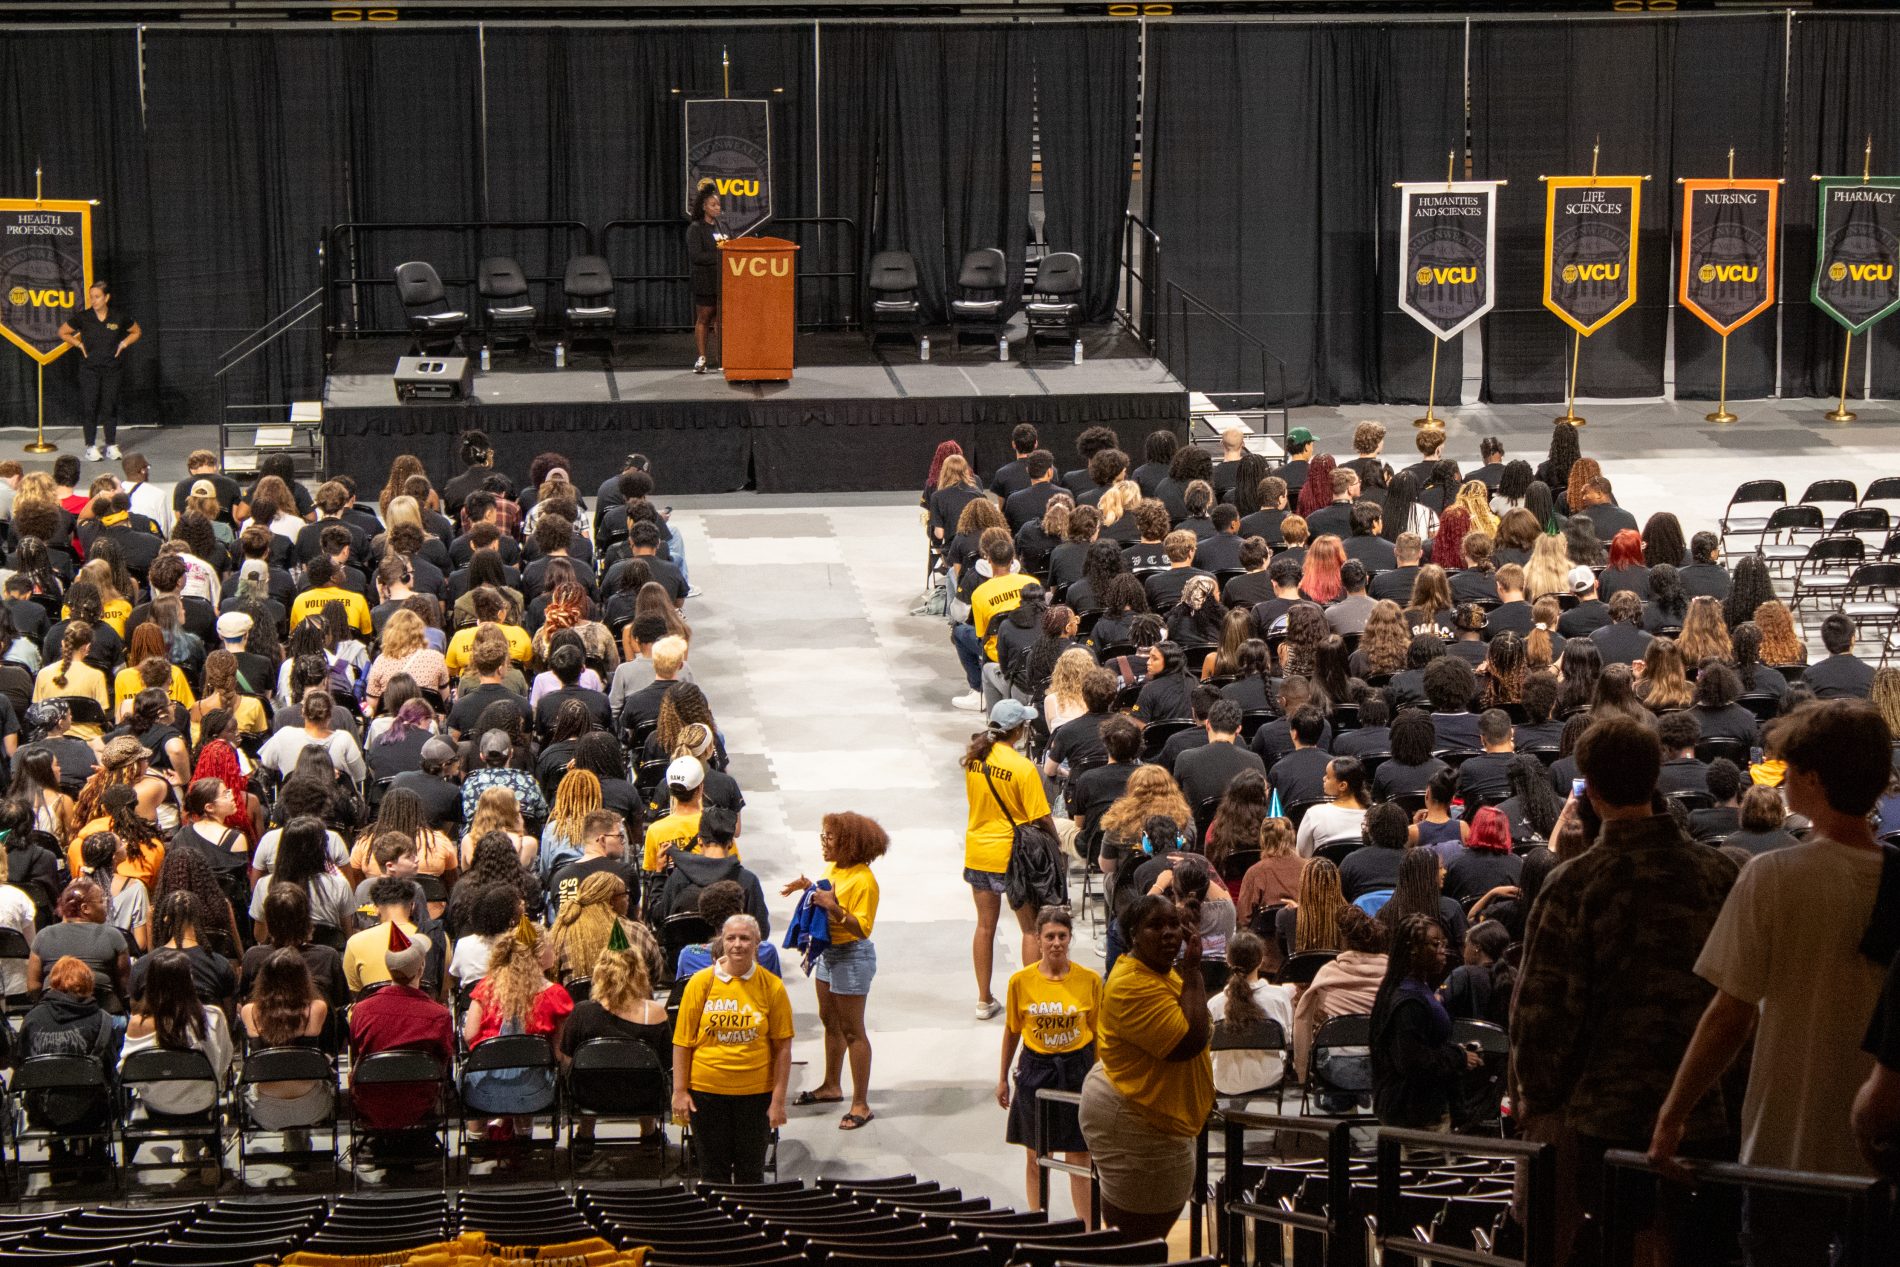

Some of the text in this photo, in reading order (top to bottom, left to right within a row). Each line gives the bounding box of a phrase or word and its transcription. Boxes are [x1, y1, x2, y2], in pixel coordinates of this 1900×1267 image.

[716, 178, 759, 197] VCU
[1419, 196, 1478, 206] HUMANITIES
[1582, 191, 1606, 202] LIFE
[1704, 193, 1757, 205] NURSING
[1833, 191, 1896, 204] PHARMACY
[1415, 207, 1482, 217] AND SCIENCES
[1565, 203, 1622, 215] SCIENCES
[18, 214, 61, 225] HEALTH
[6, 225, 74, 236] PROFESSIONS
[728, 257, 789, 277] VCU
[1577, 263, 1620, 281] VCU
[1716, 264, 1758, 283] VCU
[1849, 264, 1893, 281] VCU
[1433, 266, 1477, 285] VCU
[28, 289, 75, 308] VCU
[704, 998, 738, 1013] RAM
[1028, 1001, 1063, 1016] RAM
[709, 1013, 752, 1027] SPIRIT
[1036, 1015, 1077, 1030] SPIRIT
[717, 1027, 759, 1044] WALK
[1043, 1028, 1081, 1046] WALK
